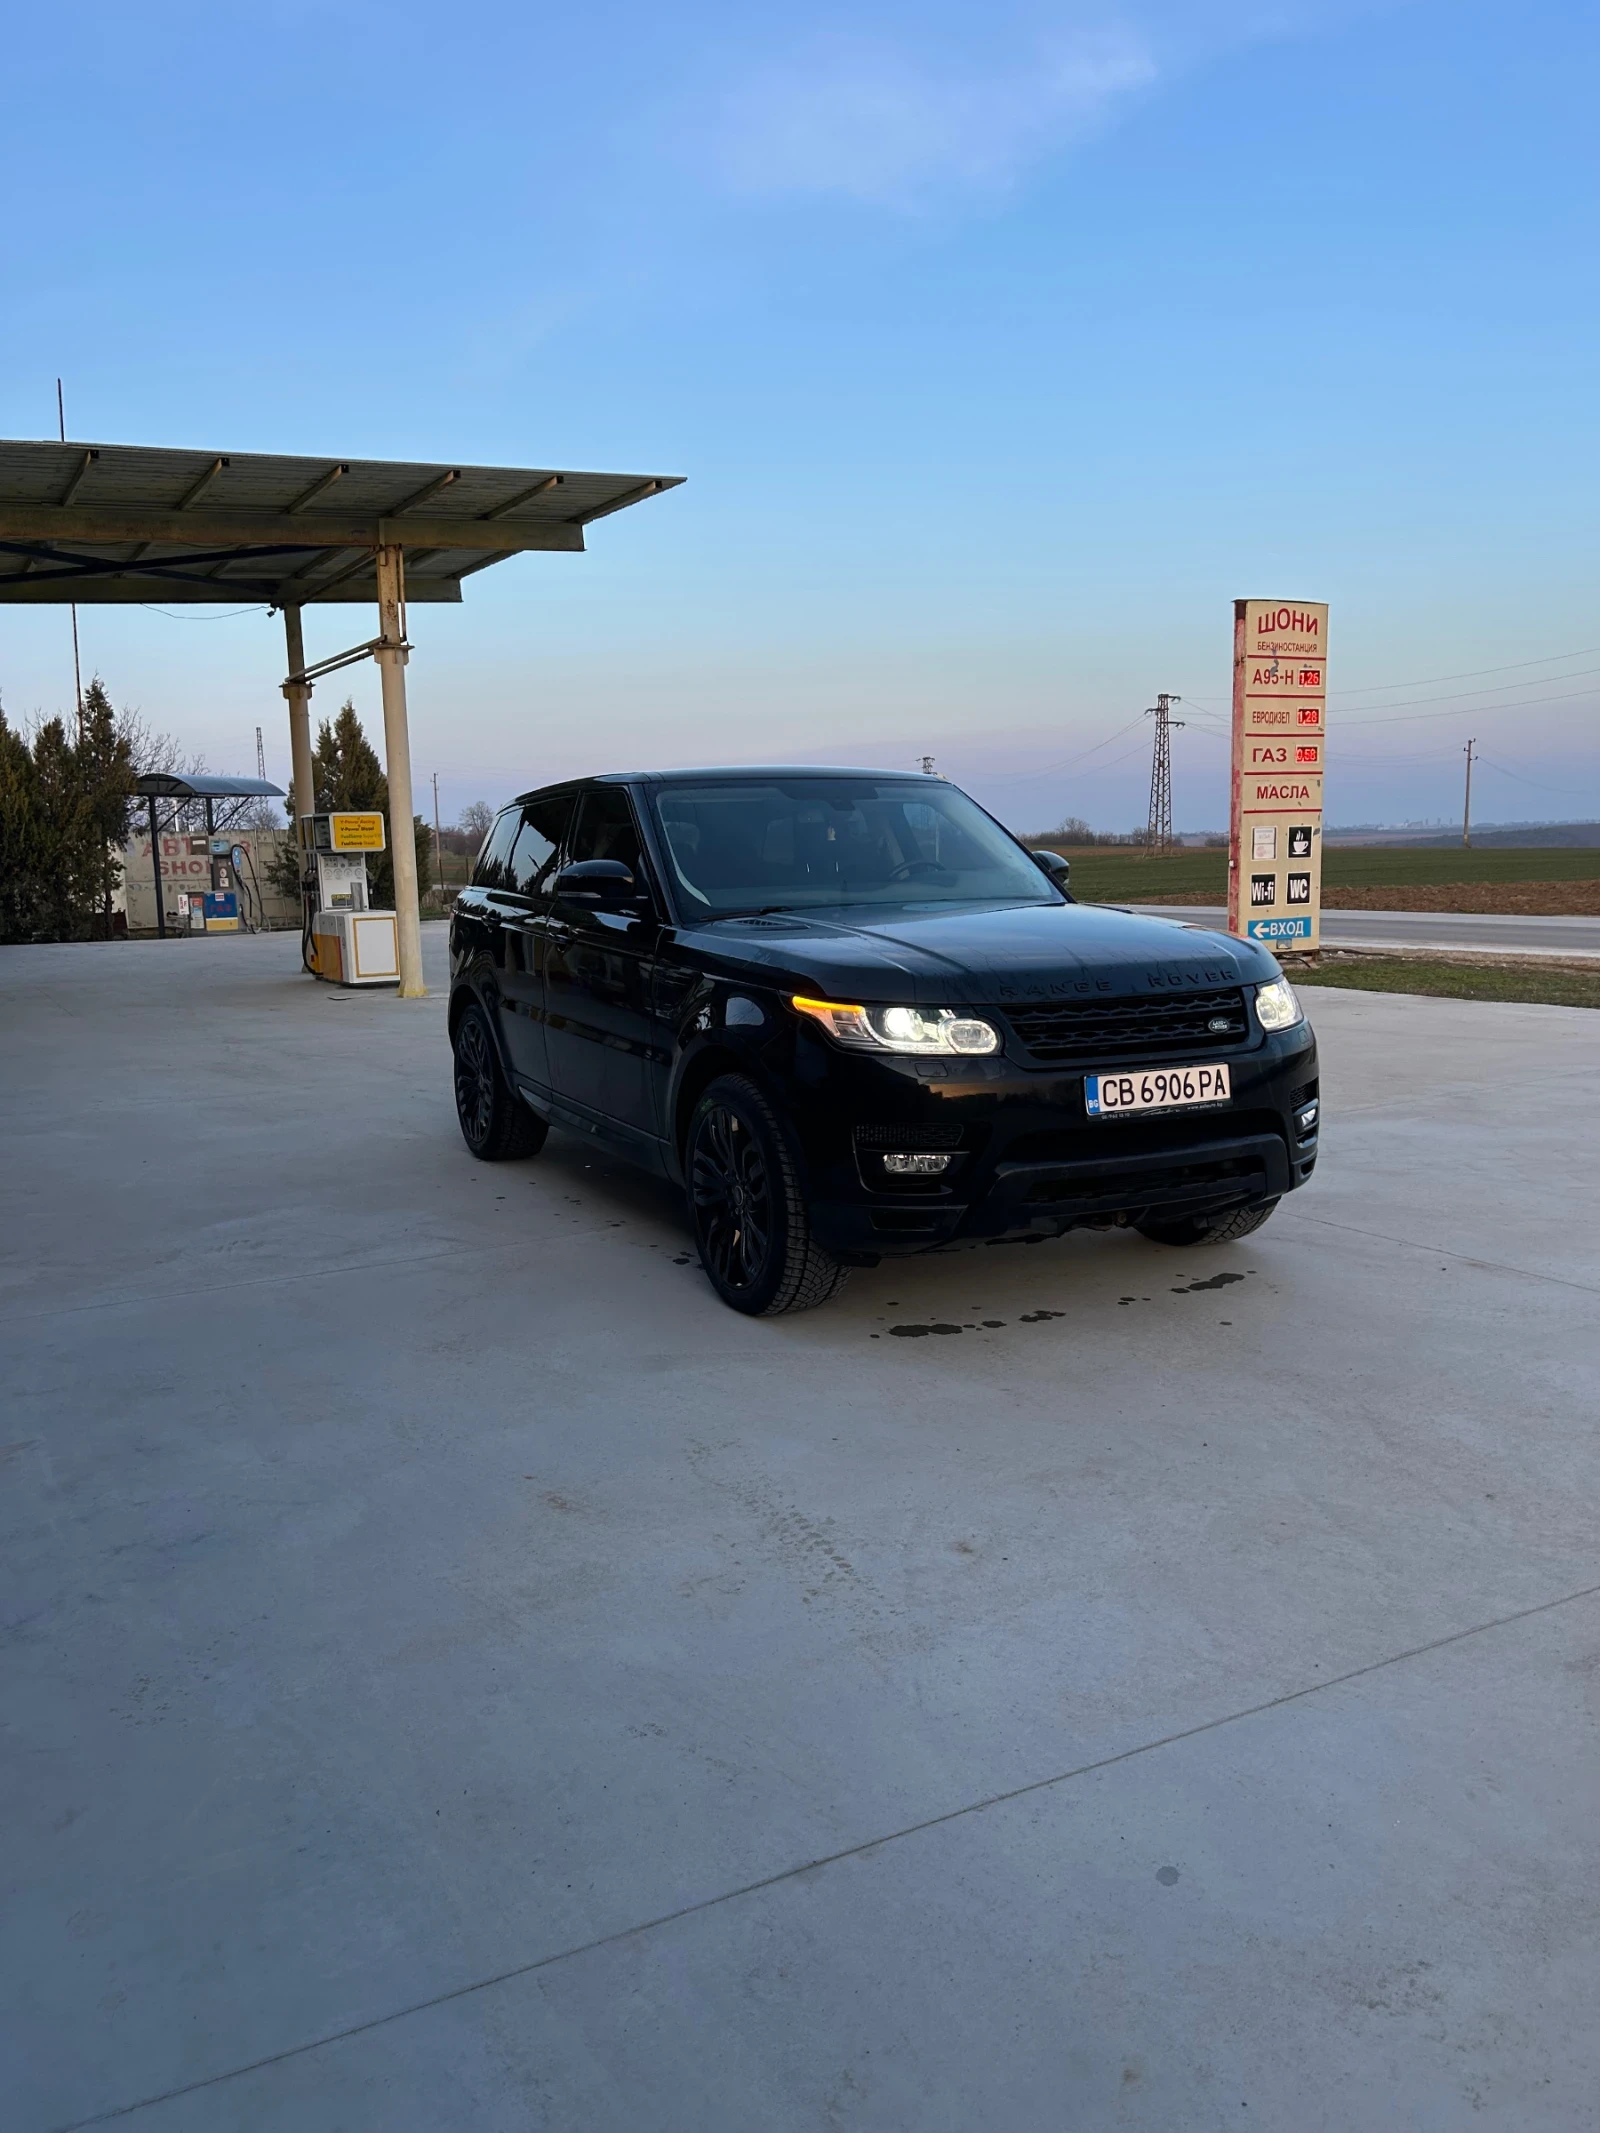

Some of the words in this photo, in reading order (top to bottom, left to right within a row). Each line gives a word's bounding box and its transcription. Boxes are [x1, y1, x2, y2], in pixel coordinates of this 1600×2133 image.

[1258, 608, 1318, 635] ШОНИ
[1257, 641, 1317, 652] БЕНЗИНОСТАНЦИЯ
[1252, 711, 1290, 725] ЕВРОДИЗЕЛ
[1252, 747, 1287, 762] ГАЗ
[1256, 785, 1310, 799] МАСЛА
[1289, 878, 1308, 899] WC
[1270, 921, 1304, 936] ВХОД
[999, 979, 1112, 997] RANGE
[1148, 970, 1236, 988] ROVER
[1102, 1078, 1135, 1107] CB
[1141, 1071, 1195, 1103] 6906
[1198, 1068, 1226, 1098] PA
[1088, 1099, 1099, 1109] BG
